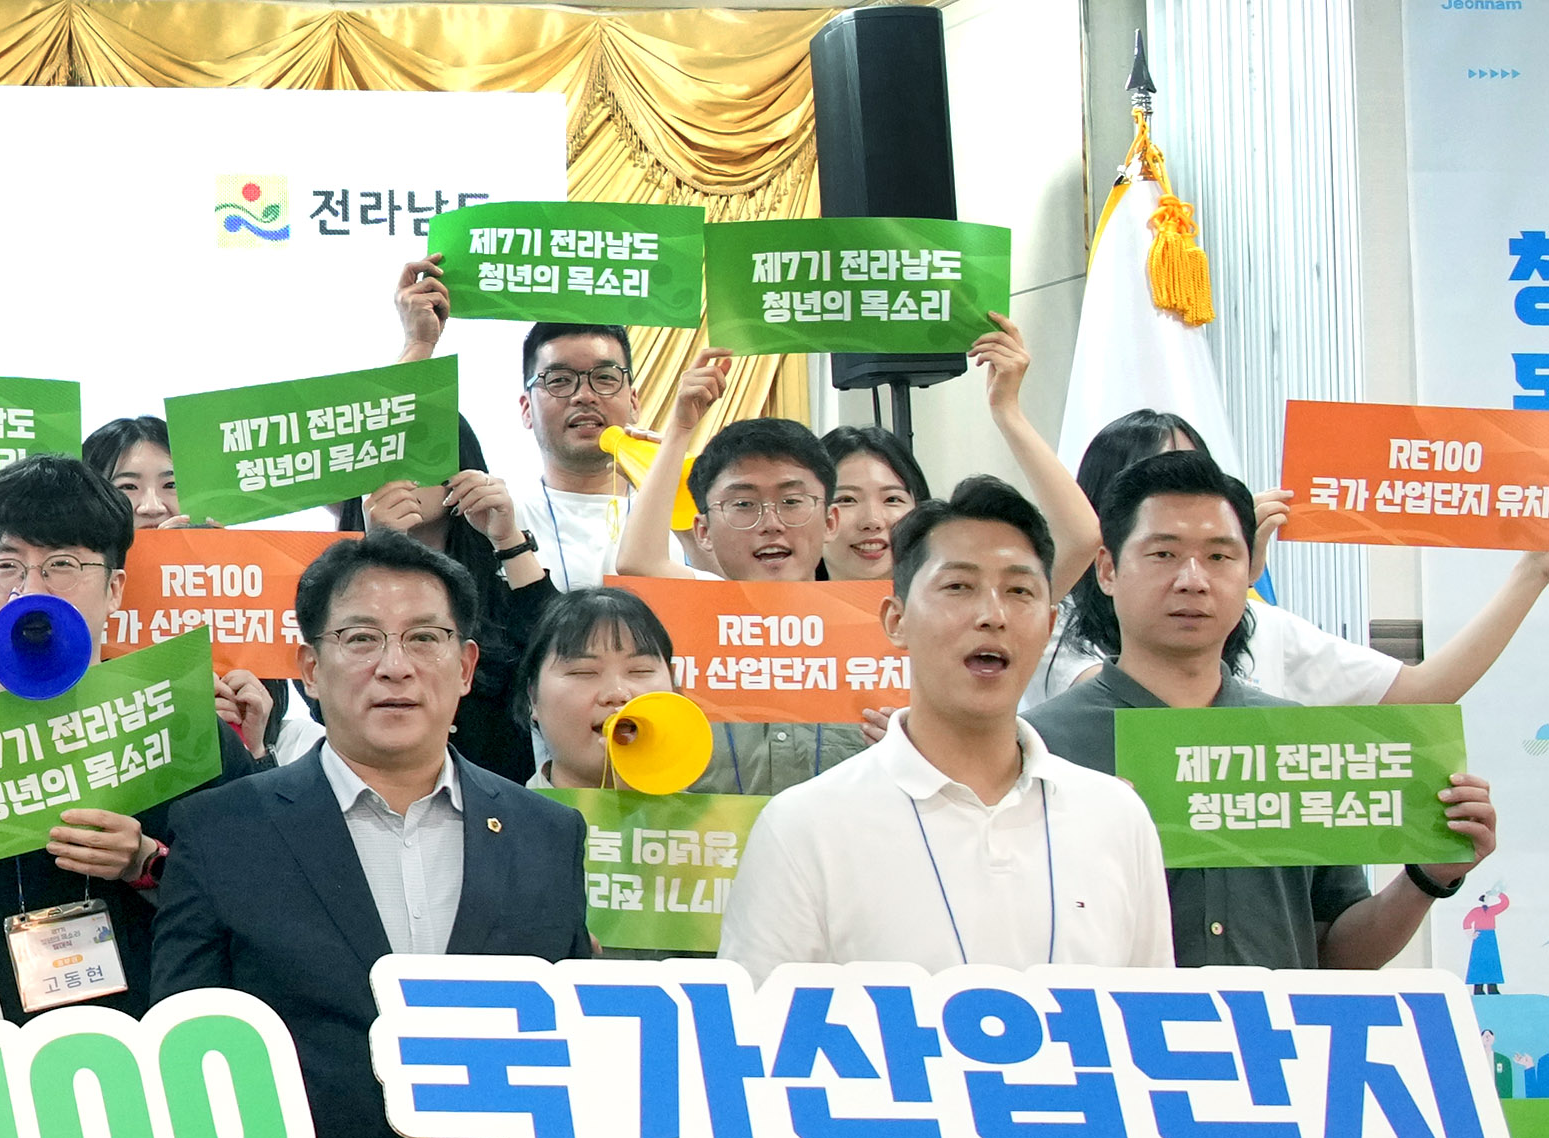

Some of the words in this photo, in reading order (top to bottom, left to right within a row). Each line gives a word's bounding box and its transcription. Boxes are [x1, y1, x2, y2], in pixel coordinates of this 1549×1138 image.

[309, 188, 489, 237] 전라남
[469, 227, 542, 260] 제7기
[549, 228, 659, 263] 전라남도
[477, 261, 560, 295] 청년의
[566, 264, 650, 299] 목소리
[751, 250, 832, 285] 제7기
[839, 249, 963, 284] 전라남도
[761, 289, 854, 326] 청년의
[859, 288, 951, 324] 목소리
[220, 411, 299, 457] 제7기
[305, 394, 417, 444] 전라남도
[235, 449, 323, 493] 청년의
[327, 431, 406, 475] 목소리
[1388, 437, 1484, 474] RE100
[1309, 476, 1370, 513] 국가
[1374, 480, 1491, 518] 산업단지
[1495, 484, 1549, 520] 유치
[160, 563, 264, 599] RE100
[716, 614, 825, 648] RE100
[671, 656, 699, 690] 가
[706, 656, 838, 691] 산업단지
[845, 656, 911, 692] 유치
[47, 679, 176, 750] 전라남도
[84, 728, 172, 790] 목소리
[1175, 744, 1267, 784] 제7기
[1273, 742, 1413, 783] 전라남도
[1186, 790, 1291, 832] 청년의
[1298, 789, 1403, 830] 목소리
[632, 827, 739, 869] 청년의
[584, 871, 645, 911] 전라
[42, 965, 105, 995] 고동현
